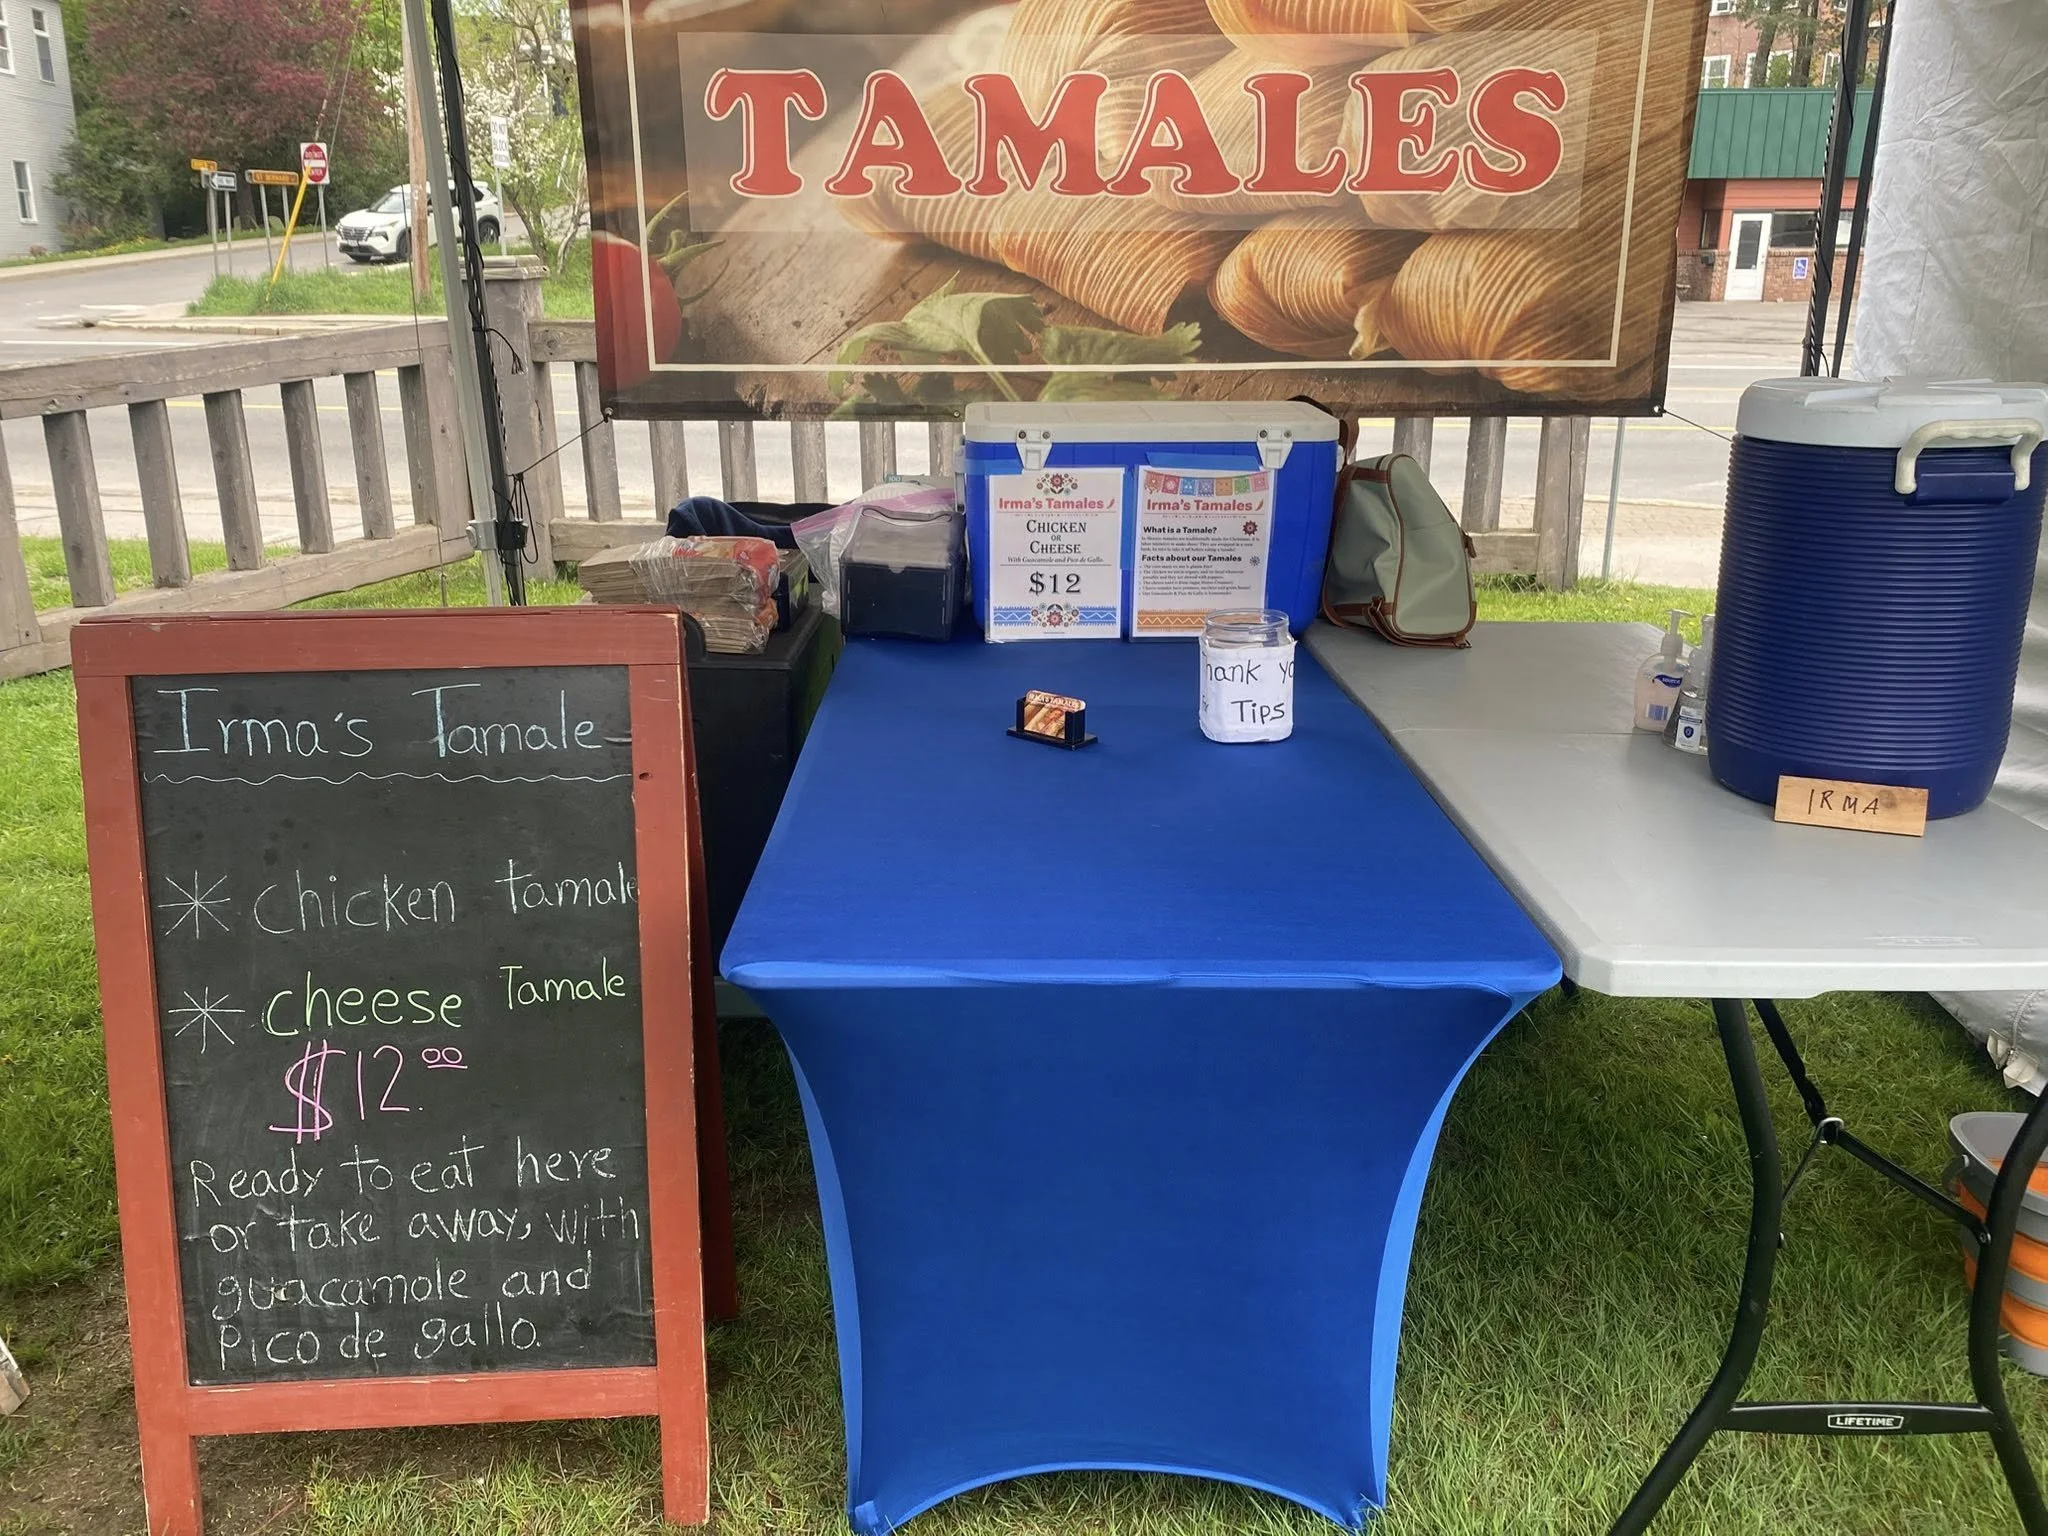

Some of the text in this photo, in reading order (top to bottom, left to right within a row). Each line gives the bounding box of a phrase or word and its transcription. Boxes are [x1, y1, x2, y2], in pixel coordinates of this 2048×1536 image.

[703, 66, 1569, 199] TAMALES
[999, 498, 1104, 509] Irma's Tamales
[1147, 499, 1252, 511] Irma's Tamales
[1026, 519, 1087, 533] CHICKEN
[1183, 526, 1218, 534] Tamale?
[1029, 540, 1082, 554] CHEESE
[1029, 571, 1081, 596] $12
[154, 683, 603, 758] Irma's Tamale
[1231, 699, 1285, 725] Tips
[1808, 788, 1880, 815] IRMA
[261, 957, 626, 1037] cheese Tamale
[189, 1135, 617, 1207] Ready to eat here
[208, 1197, 640, 1254] or take away, with
[212, 1249, 594, 1322] guacamole and
[340, 1311, 388, 1360] de
[414, 1301, 542, 1360] gallo.
[1836, 1416, 1895, 1426] LIFETIME
